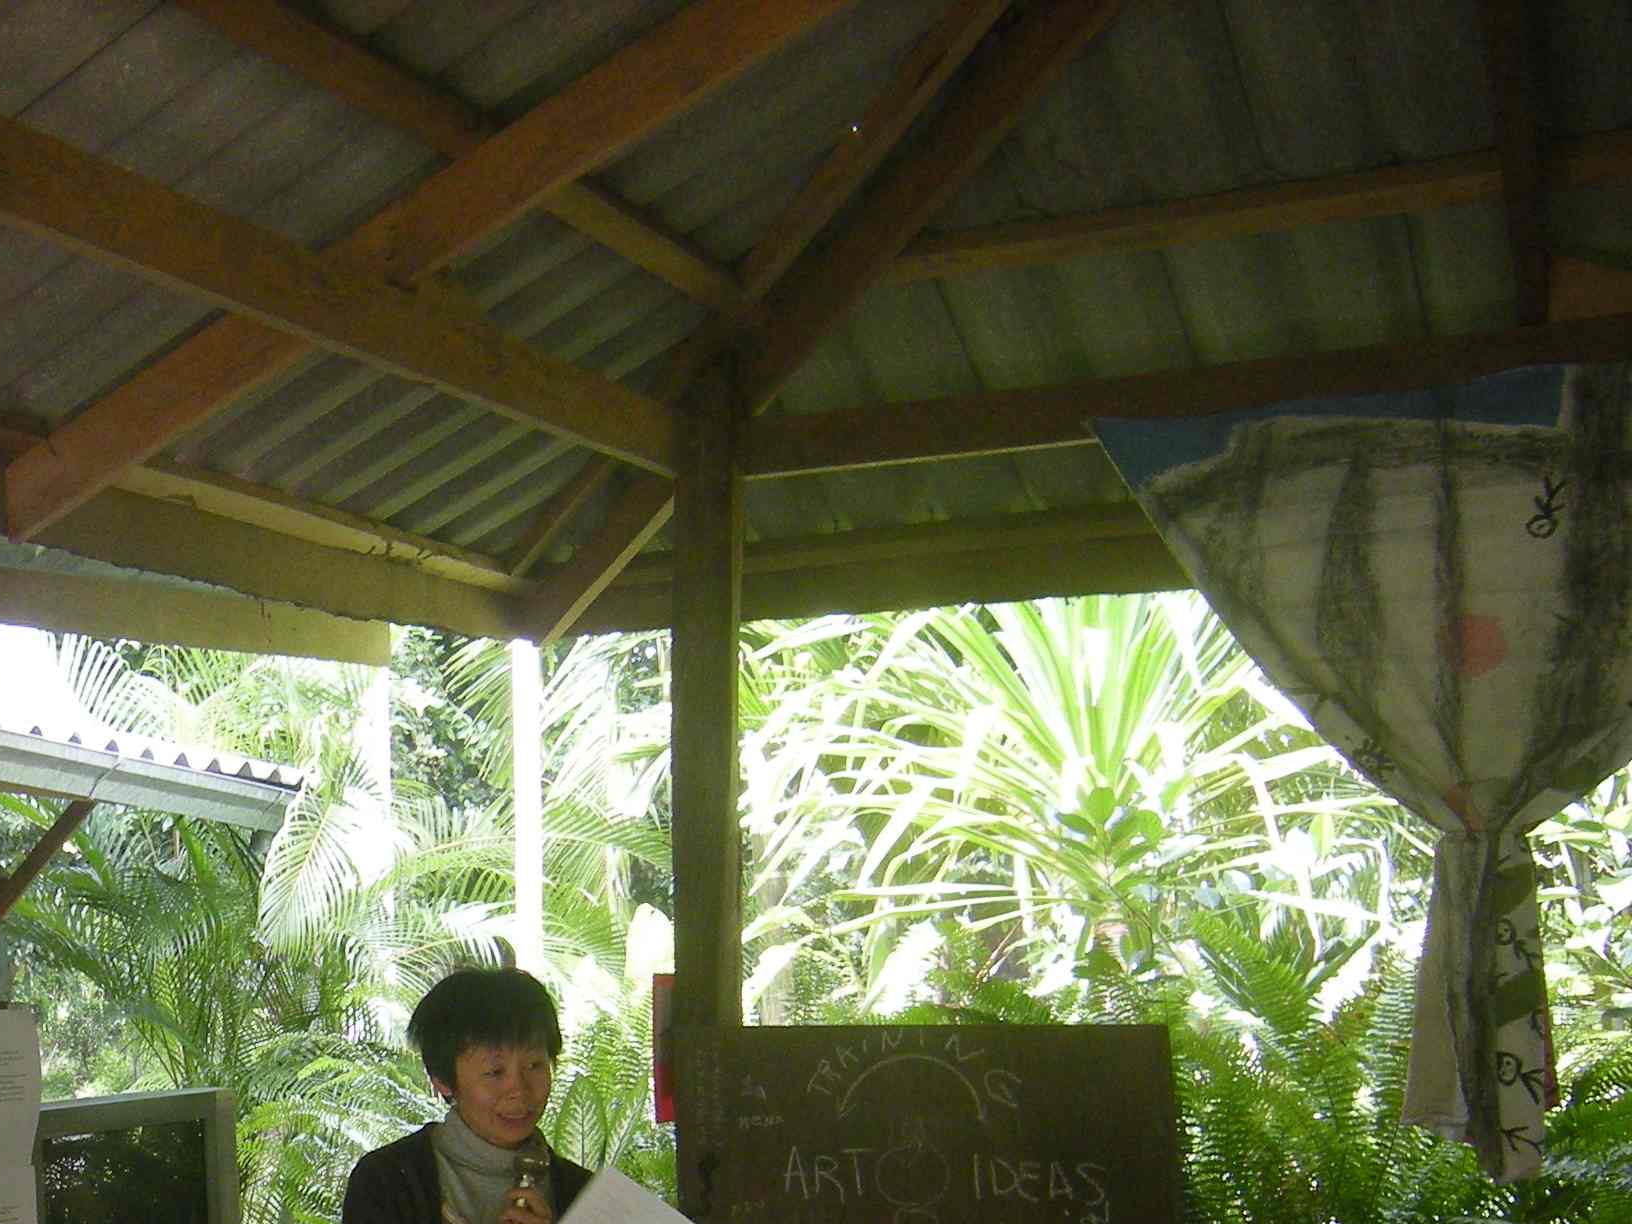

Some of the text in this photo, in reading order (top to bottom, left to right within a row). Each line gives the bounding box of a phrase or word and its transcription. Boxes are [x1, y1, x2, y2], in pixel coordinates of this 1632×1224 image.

[805, 1028, 1024, 1110] TRAINING
[783, 1144, 1108, 1206] ART IDEAS
